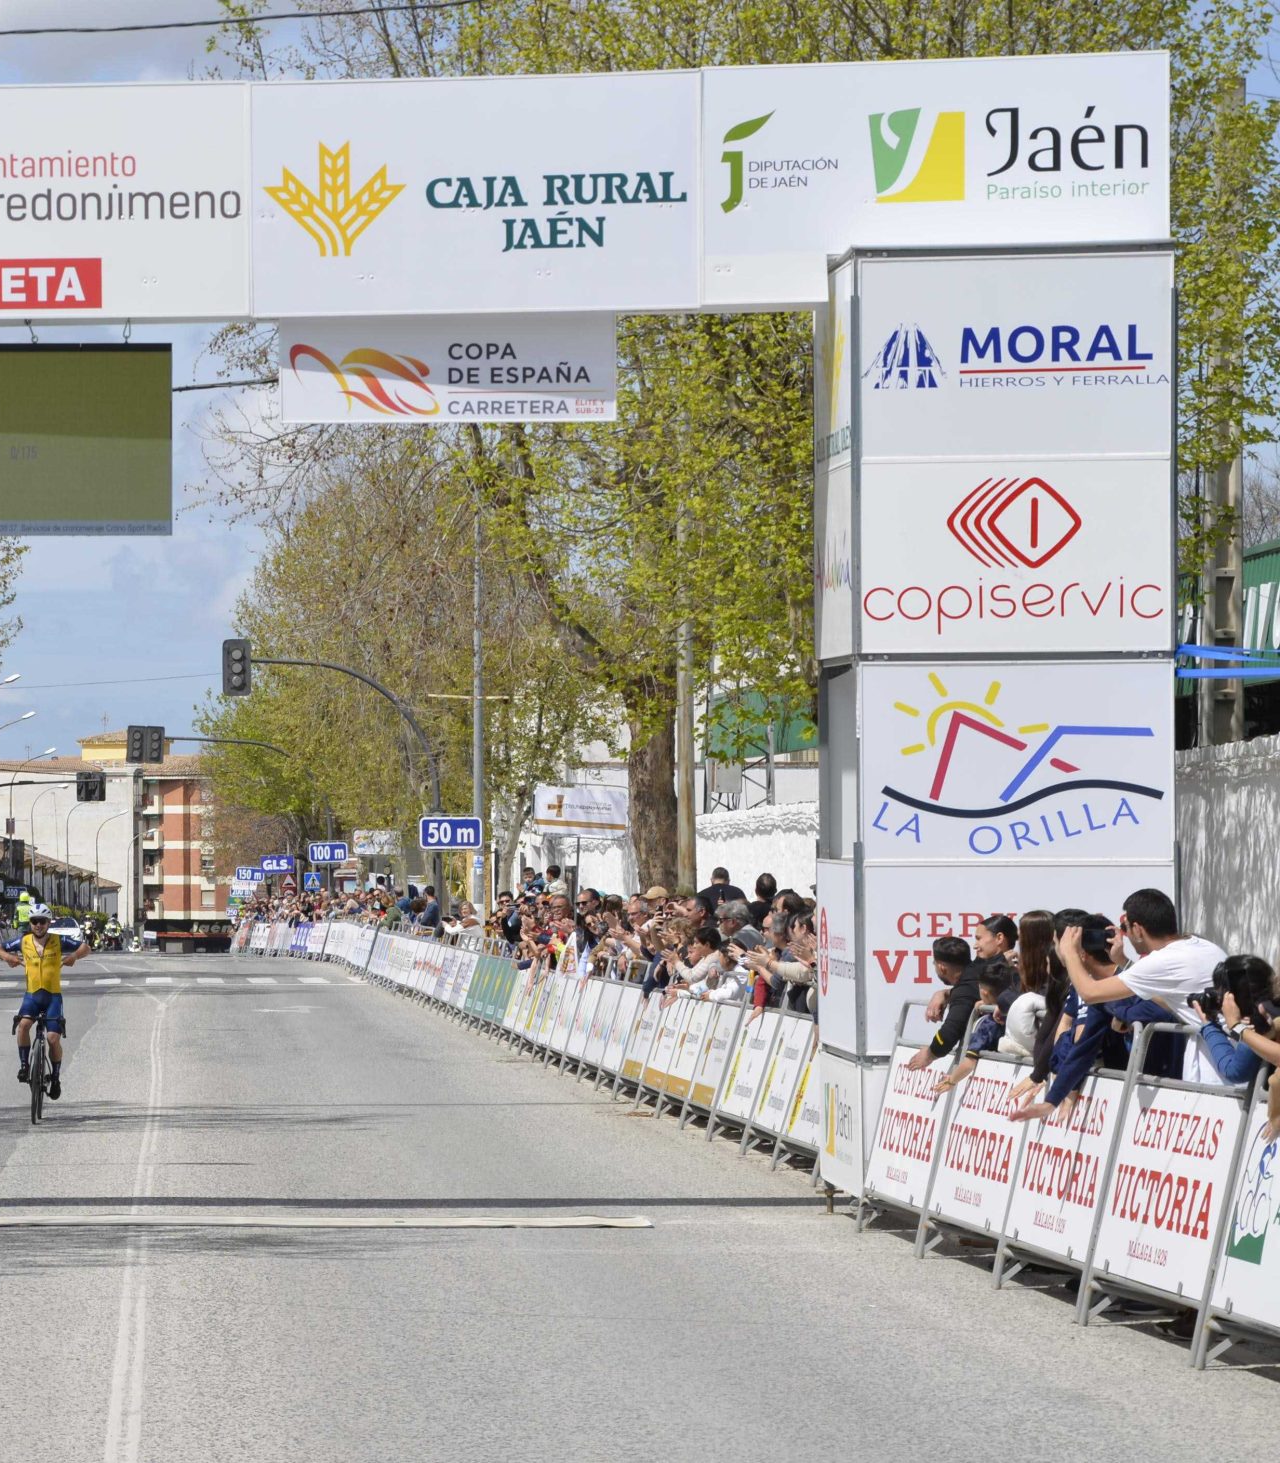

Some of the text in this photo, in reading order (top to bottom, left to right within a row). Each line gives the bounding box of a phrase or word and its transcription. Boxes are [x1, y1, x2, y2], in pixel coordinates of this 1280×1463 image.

[985, 105, 1149, 177] Jaén
[748, 157, 838, 173] DIPUTACIÓN
[426, 172, 687, 211] CAJA RURAL
[748, 174, 808, 189] DE JAÉN
[987, 180, 1150, 201] Paraíso interior
[502, 211, 606, 252] JAÉN
[448, 343, 517, 360] COPA
[960, 324, 1153, 364] MORAL
[448, 362, 591, 384] DE ESPAÑA
[960, 374, 1170, 388] HIERROS Y FERRALLA
[448, 400, 569, 416] CARRETERA
[863, 576, 1164, 634] copiservic
[427, 823, 475, 844] 50 m
[872, 798, 1140, 855] LA ORILLA
[312, 845, 344, 860] 100 m
[238, 869, 262, 880] 150 m
[6, 889, 18, 897] 200
[878, 1107, 936, 1163] VICTORIA
[1132, 1107, 1224, 1160] CERVEZAS
[945, 1122, 1013, 1184] VICTORIA
[1022, 1141, 1100, 1209] VICTORIA
[1111, 1164, 1214, 1240] VICTORIA
